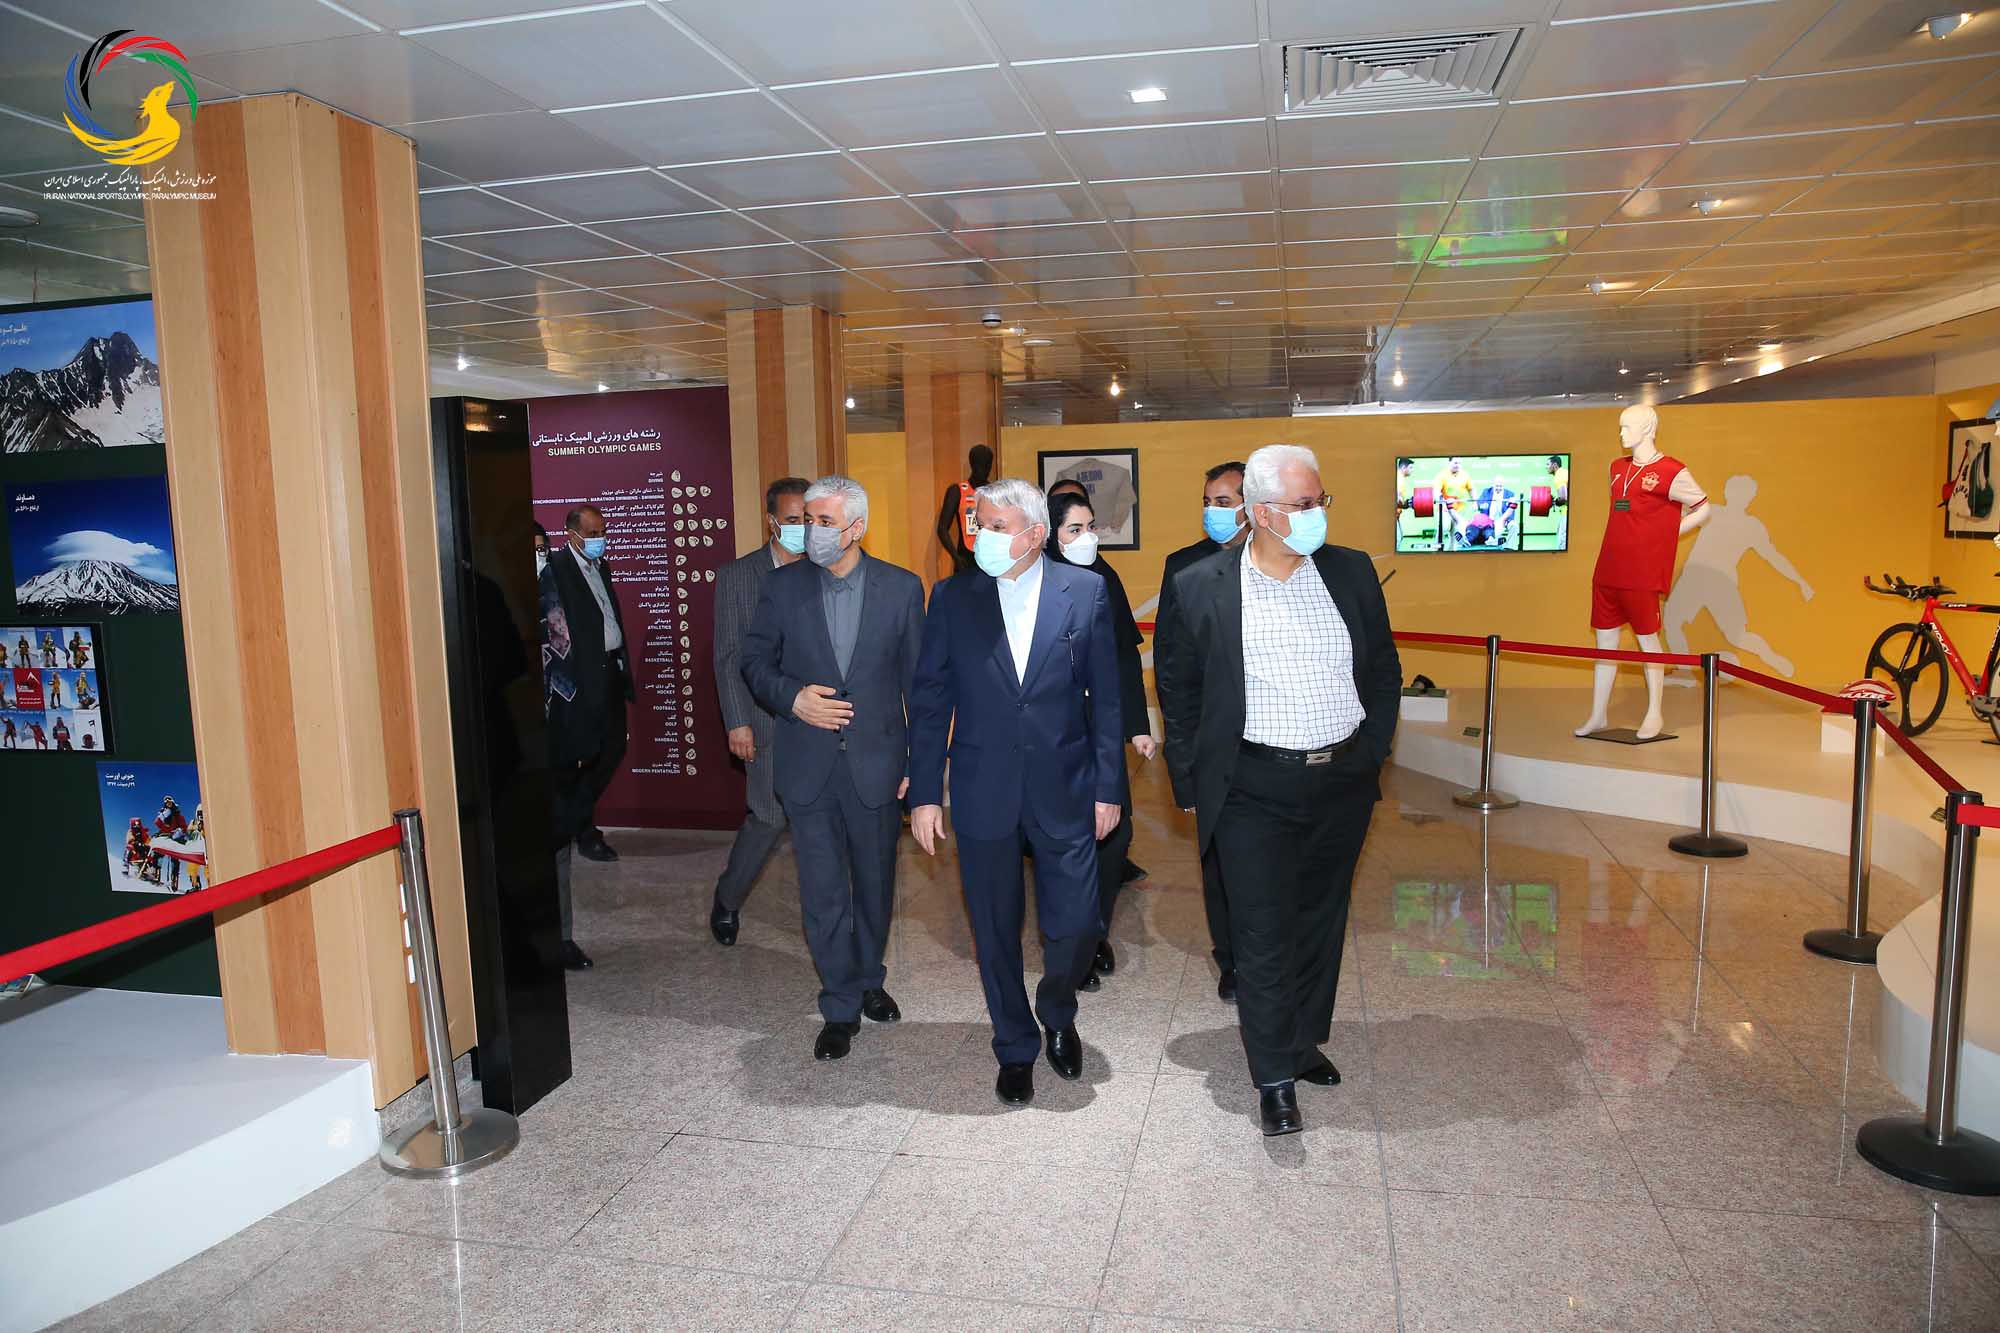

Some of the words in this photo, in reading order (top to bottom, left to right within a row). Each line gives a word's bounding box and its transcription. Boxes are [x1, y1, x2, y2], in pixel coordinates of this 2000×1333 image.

[532, 433, 563, 447] تابستانی
[564, 431, 592, 445] المپیک
[593, 430, 621, 443] ورزشی
[623, 429, 639, 440] های
[640, 428, 661, 440] رشته
[548, 446, 586, 457] SUMMER
[587, 444, 627, 455] OLYMPIC
[629, 442, 662, 453] GAMES
